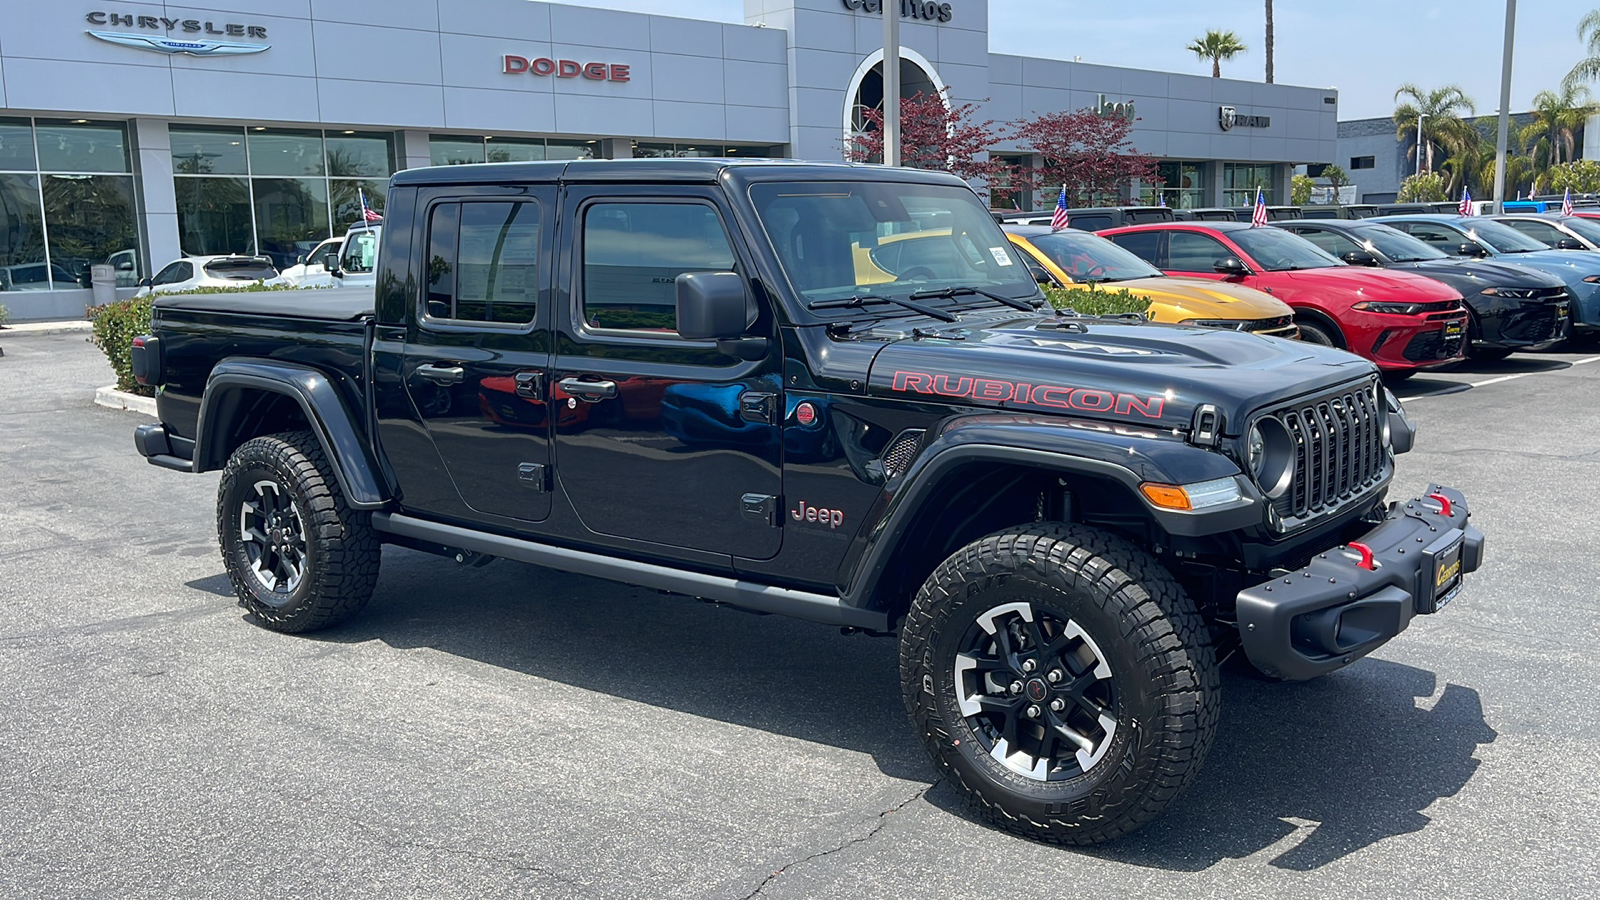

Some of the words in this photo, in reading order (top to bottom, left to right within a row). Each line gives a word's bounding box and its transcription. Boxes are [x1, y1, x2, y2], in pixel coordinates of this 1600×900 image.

[85, 11, 268, 38] CHRYSLER
[841, 0, 952, 22] eitos
[502, 54, 630, 82] DODGE
[1090, 93, 1135, 122] Jeep
[1235, 114, 1270, 128] RAM
[892, 371, 1165, 418] RUBICON
[791, 501, 844, 529] Jeep
